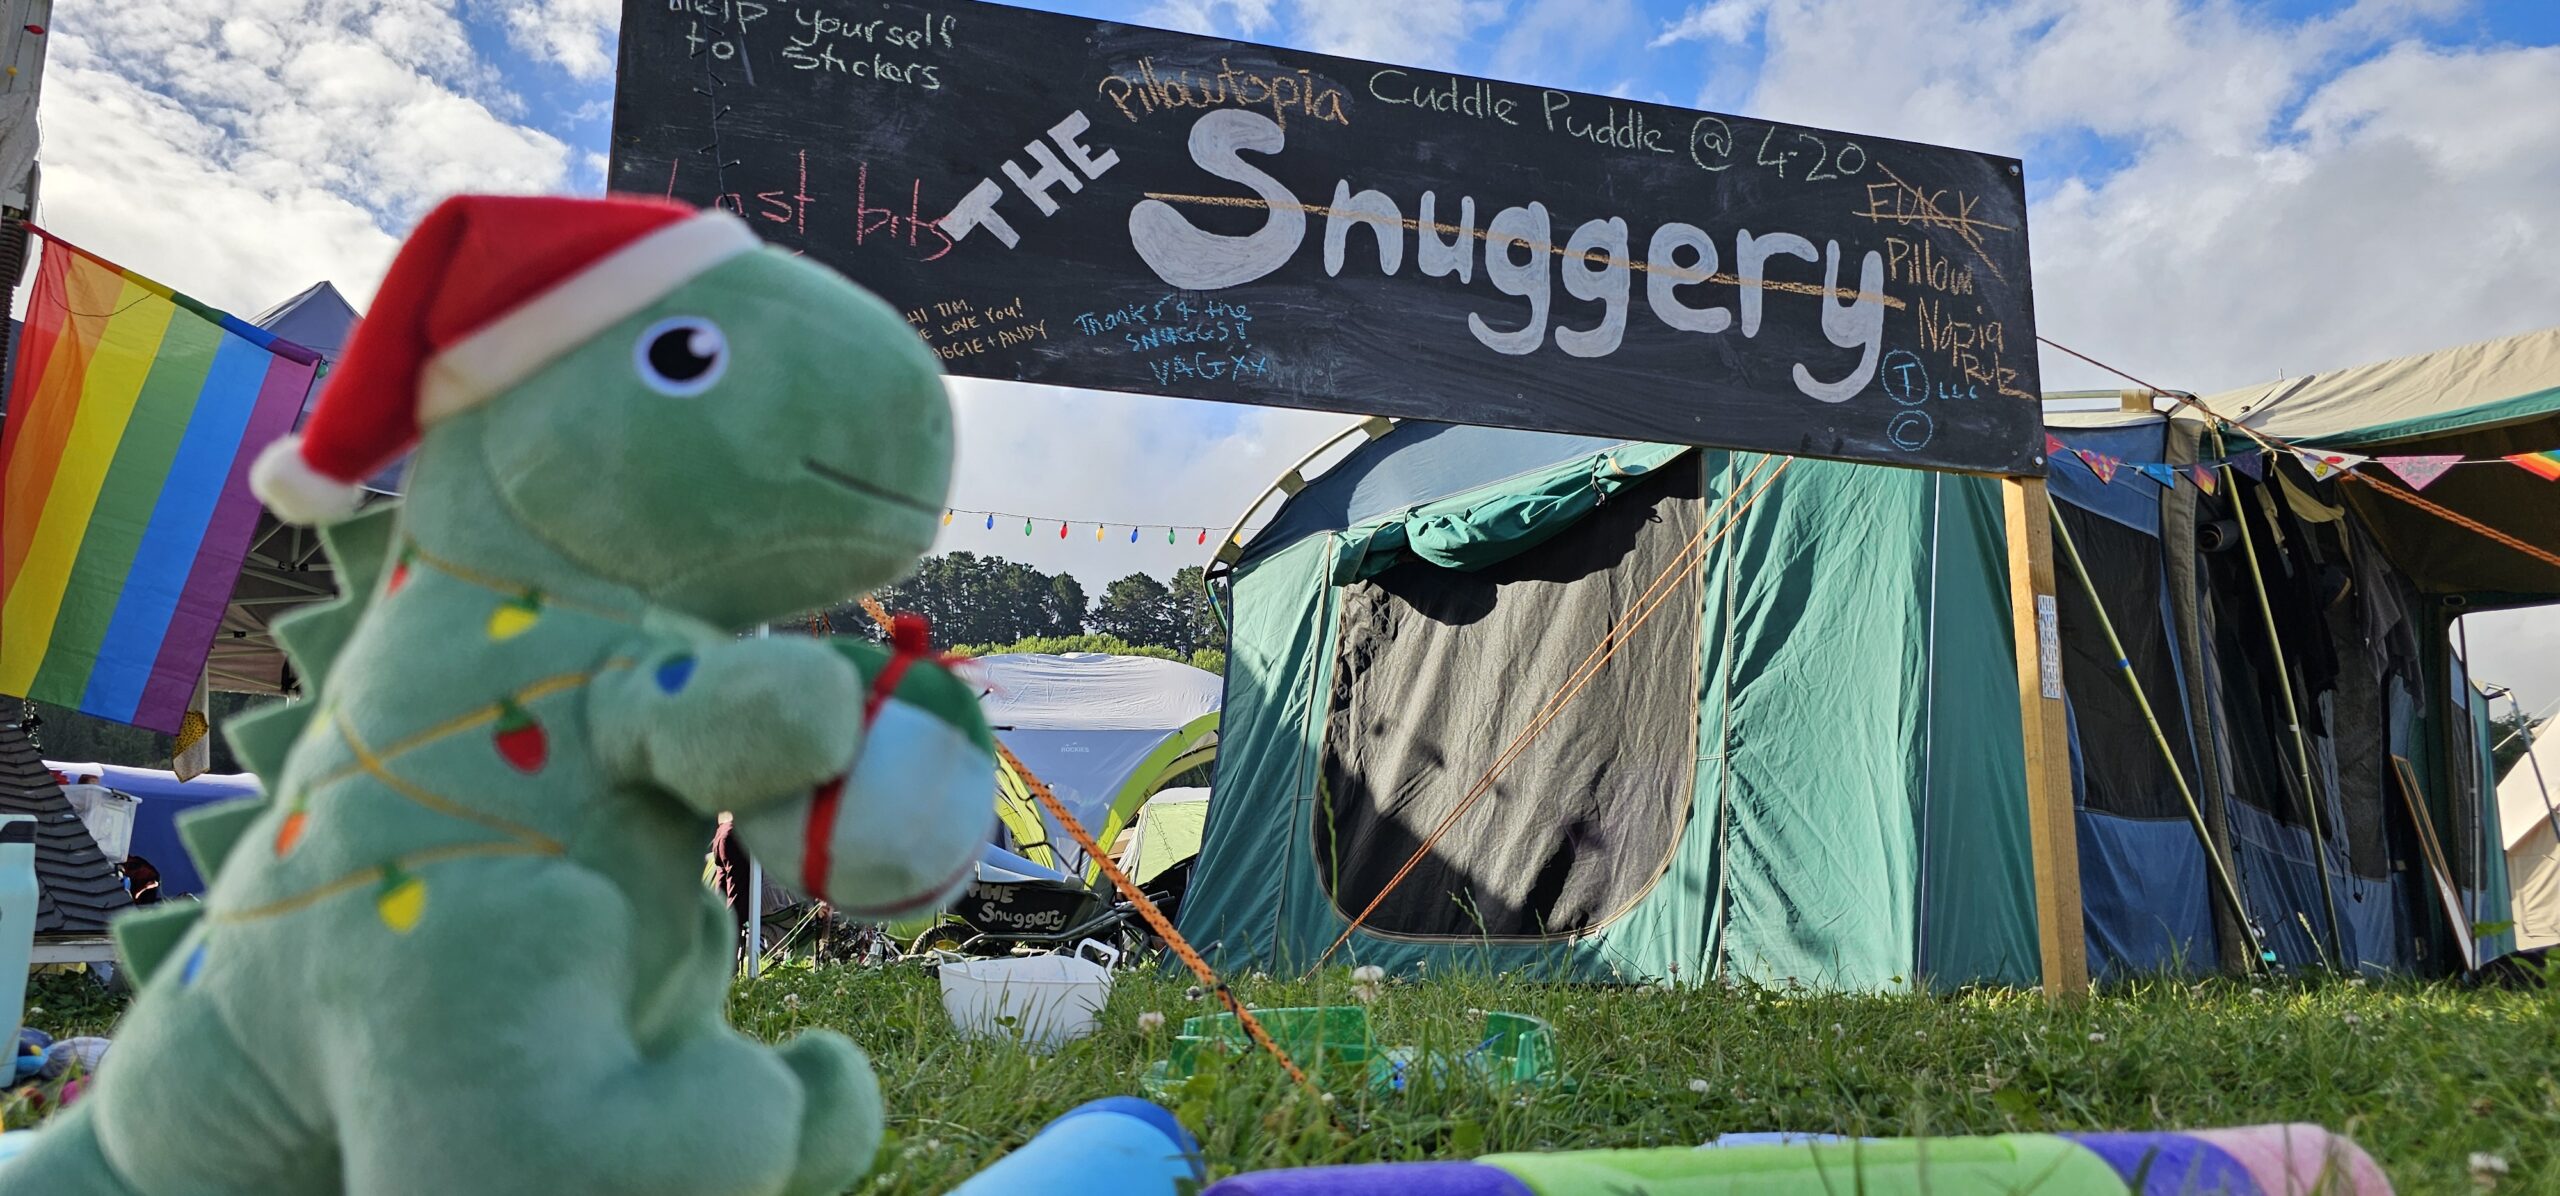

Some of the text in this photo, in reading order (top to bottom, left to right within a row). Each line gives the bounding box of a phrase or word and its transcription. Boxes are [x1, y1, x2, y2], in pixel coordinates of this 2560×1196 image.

[670, 0, 957, 49] elp yourself
[686, 20, 735, 60] to
[1369, 69, 1519, 126] Cuddle
[1542, 89, 1675, 154] Puddle
[1690, 116, 1733, 171] @
[937, 109, 1121, 250] THE
[1128, 108, 1884, 403] Snuggery
[907, 307, 928, 325] HI
[941, 316, 980, 335] LOVE
[931, 338, 985, 360] AGGIE
[998, 319, 1048, 349] ANDY
[977, 901, 1068, 931] Snuggery
